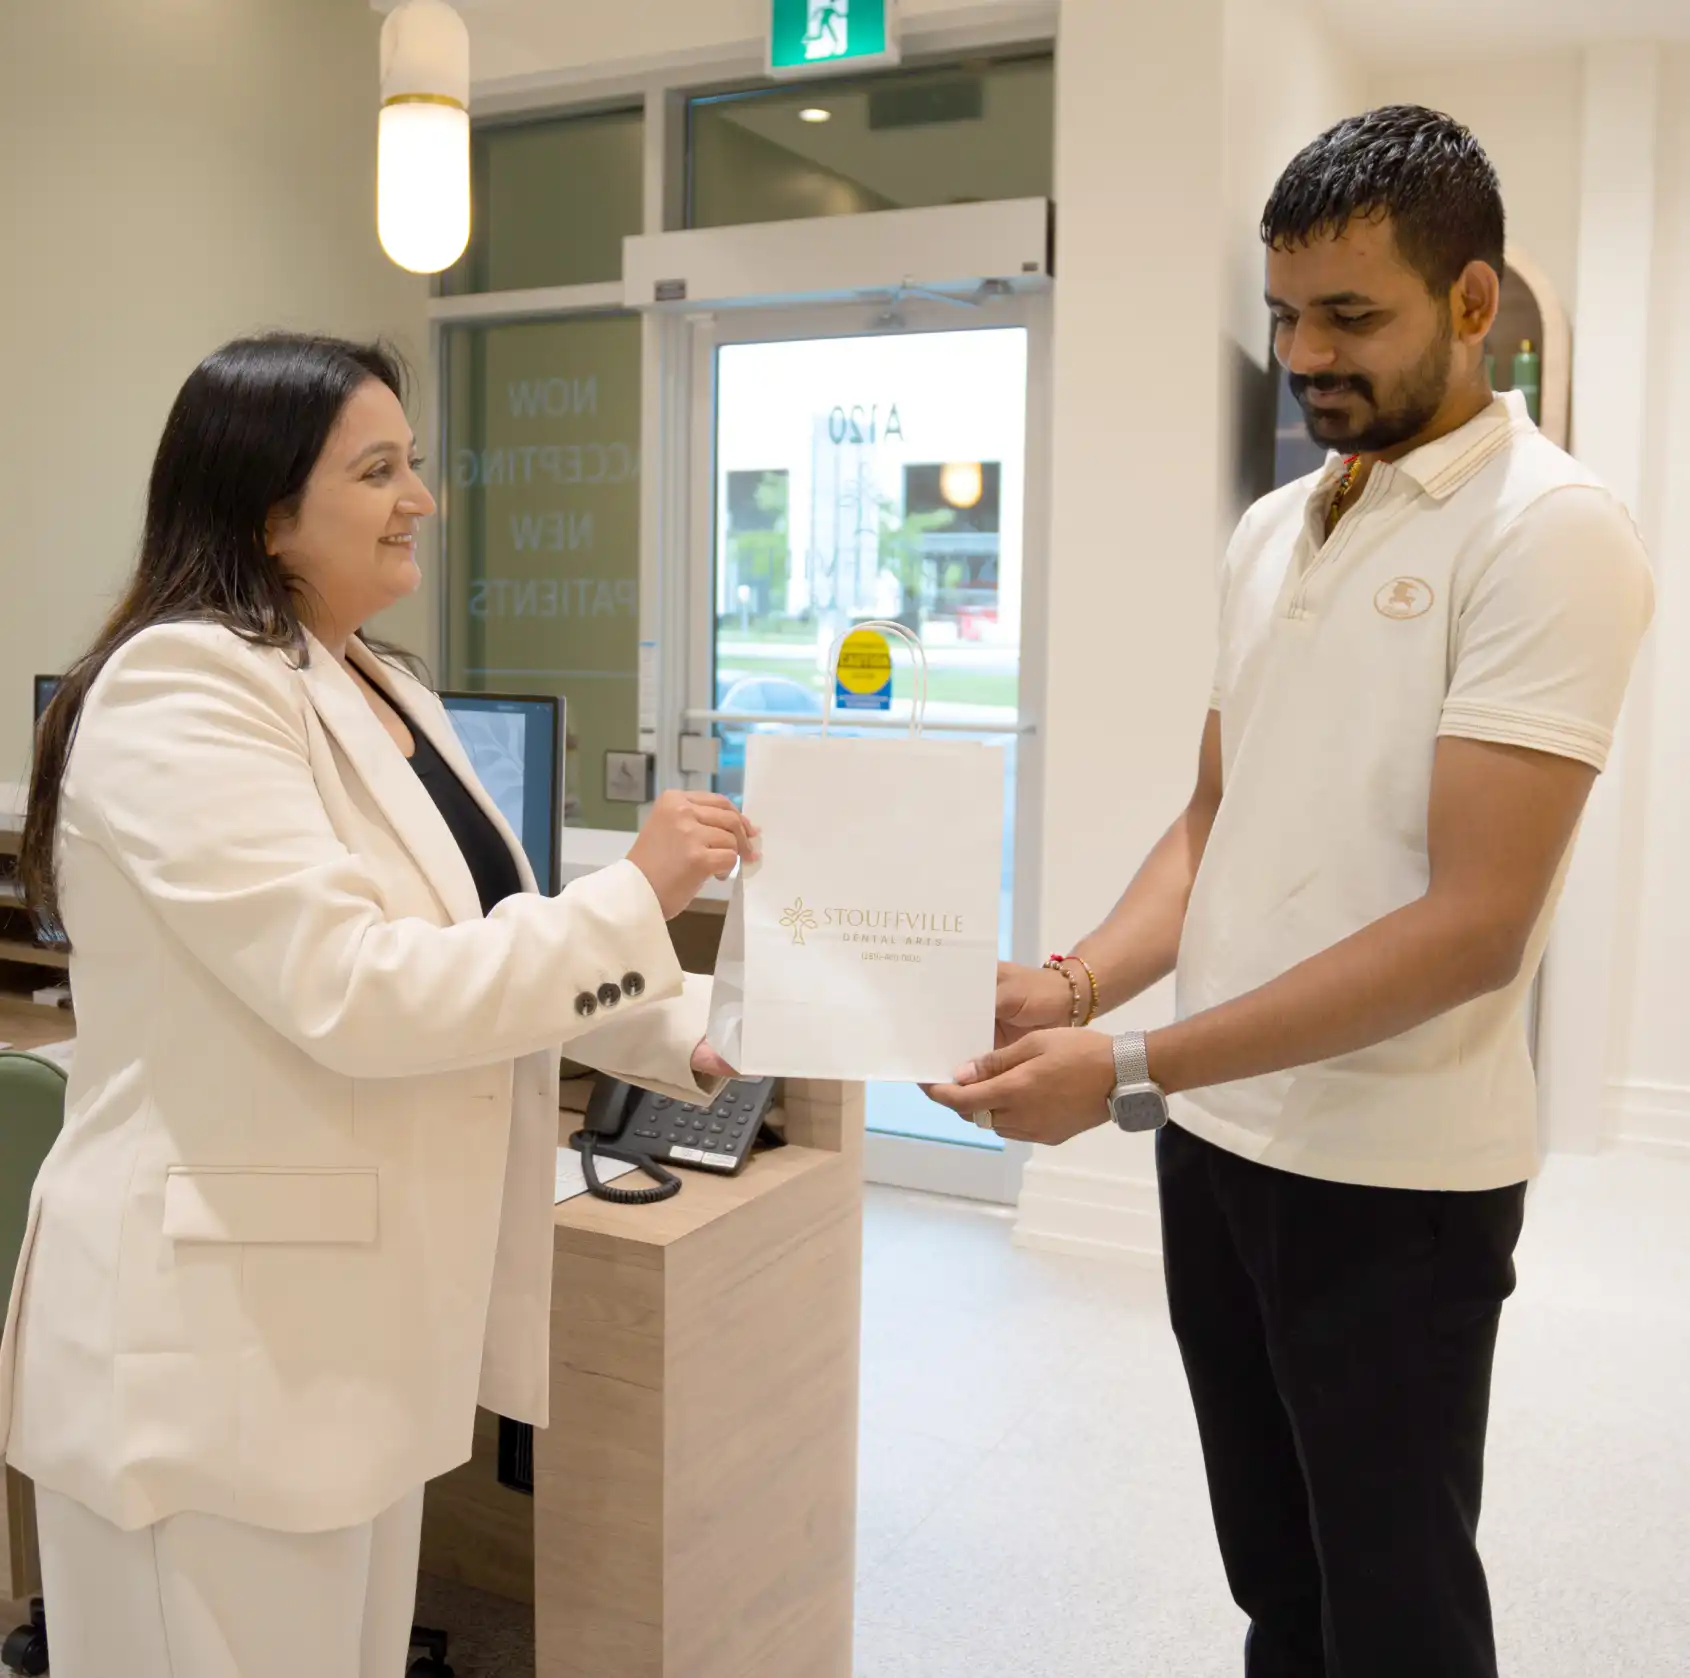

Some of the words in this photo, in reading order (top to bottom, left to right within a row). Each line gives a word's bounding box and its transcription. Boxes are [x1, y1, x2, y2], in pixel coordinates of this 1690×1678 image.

[824, 908, 963, 932] STOUFFVILLE
[843, 933, 896, 944] DENTAL
[905, 936, 943, 947] ARTS
